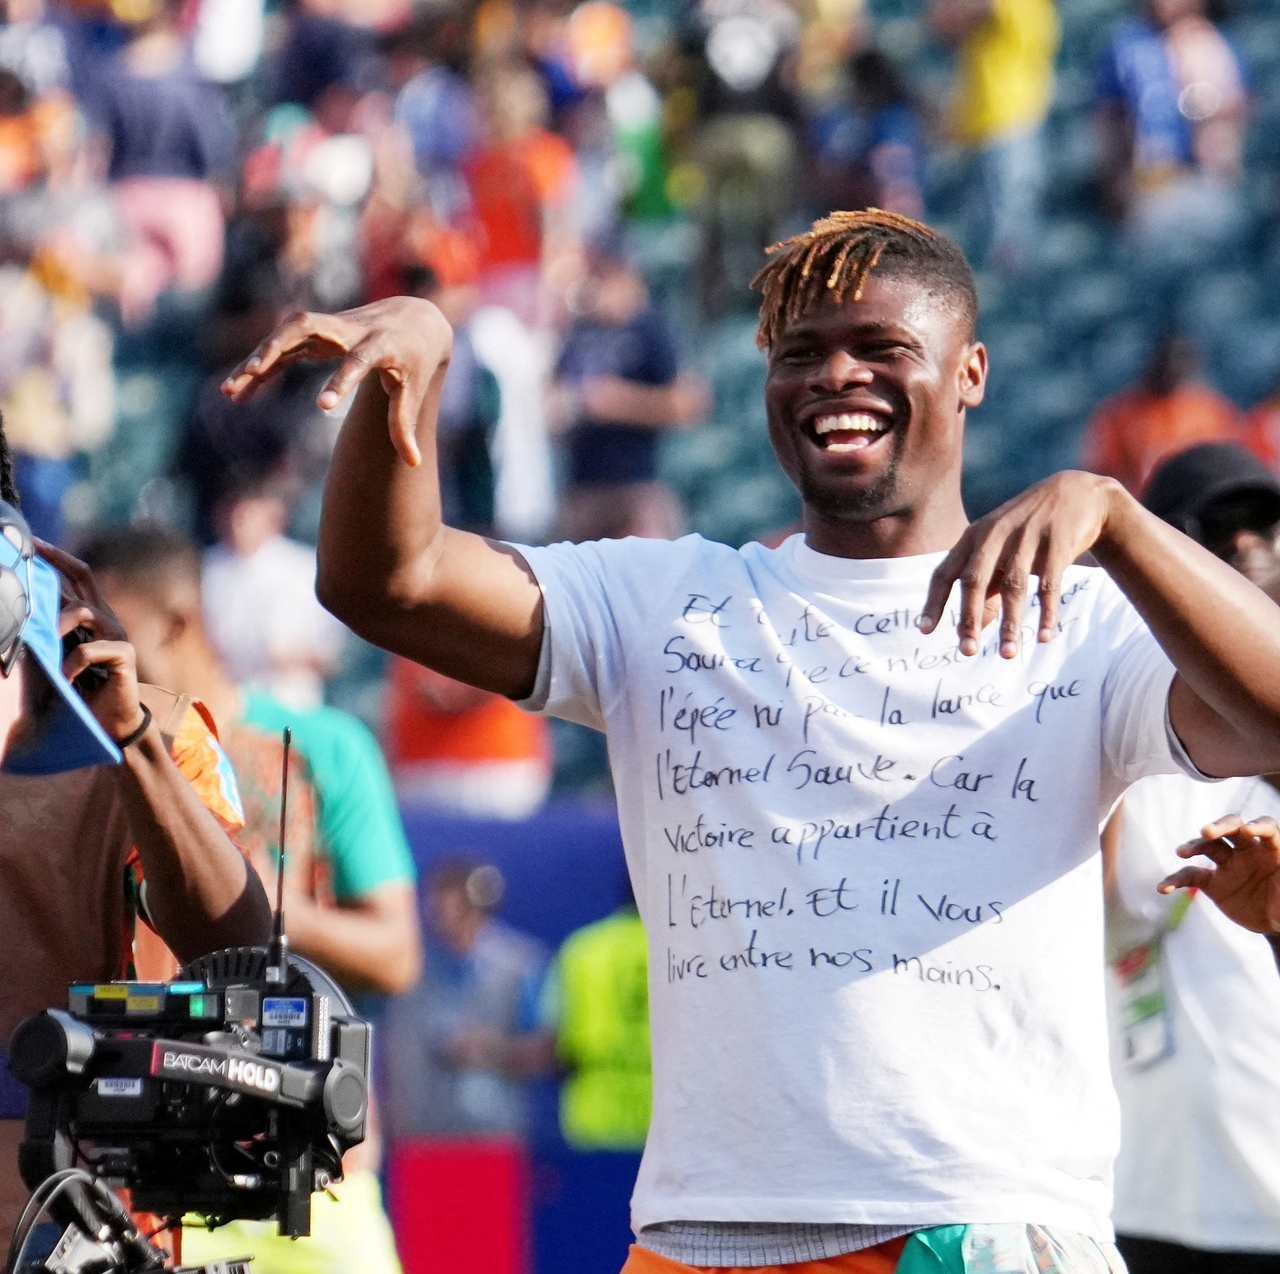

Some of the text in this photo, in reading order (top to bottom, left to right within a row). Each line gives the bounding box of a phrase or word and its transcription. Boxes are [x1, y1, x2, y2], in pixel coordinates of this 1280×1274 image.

[682, 593, 733, 628] Et
[753, 699, 783, 729] ni
[879, 686, 911, 728] la
[1027, 679, 1085, 724] que
[930, 755, 994, 792] Car
[1011, 757, 1039, 802] la
[771, 803, 963, 866] appartient
[805, 877, 860, 917] Et
[881, 878, 901, 916] il
[667, 948, 708, 984] livre
[719, 930, 794, 970] entre
[809, 947, 874, 973] nos
[163, 1051, 281, 1092] BATCAM HOLD
